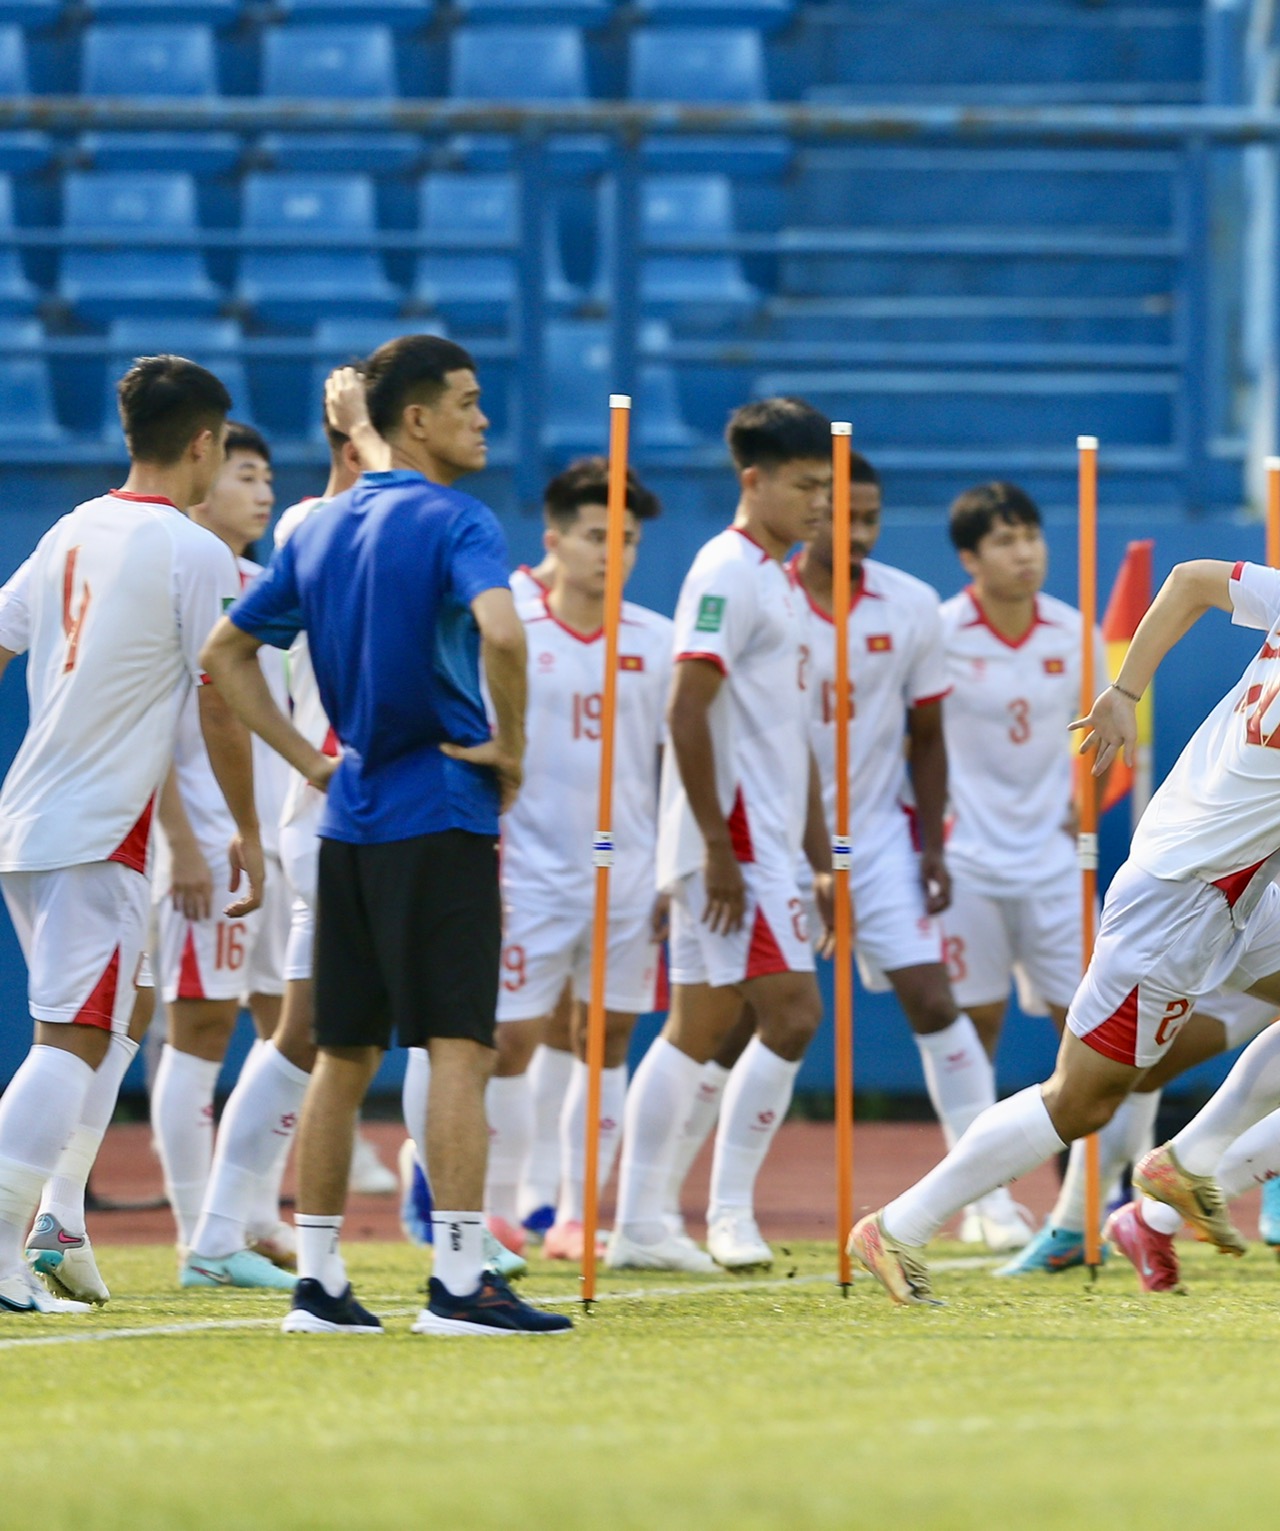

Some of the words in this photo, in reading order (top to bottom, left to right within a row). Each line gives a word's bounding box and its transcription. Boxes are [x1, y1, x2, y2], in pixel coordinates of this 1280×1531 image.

[572, 691, 605, 741] 19
[821, 679, 856, 724] 1
[1006, 698, 1031, 745] 3
[215, 921, 247, 971] 16
